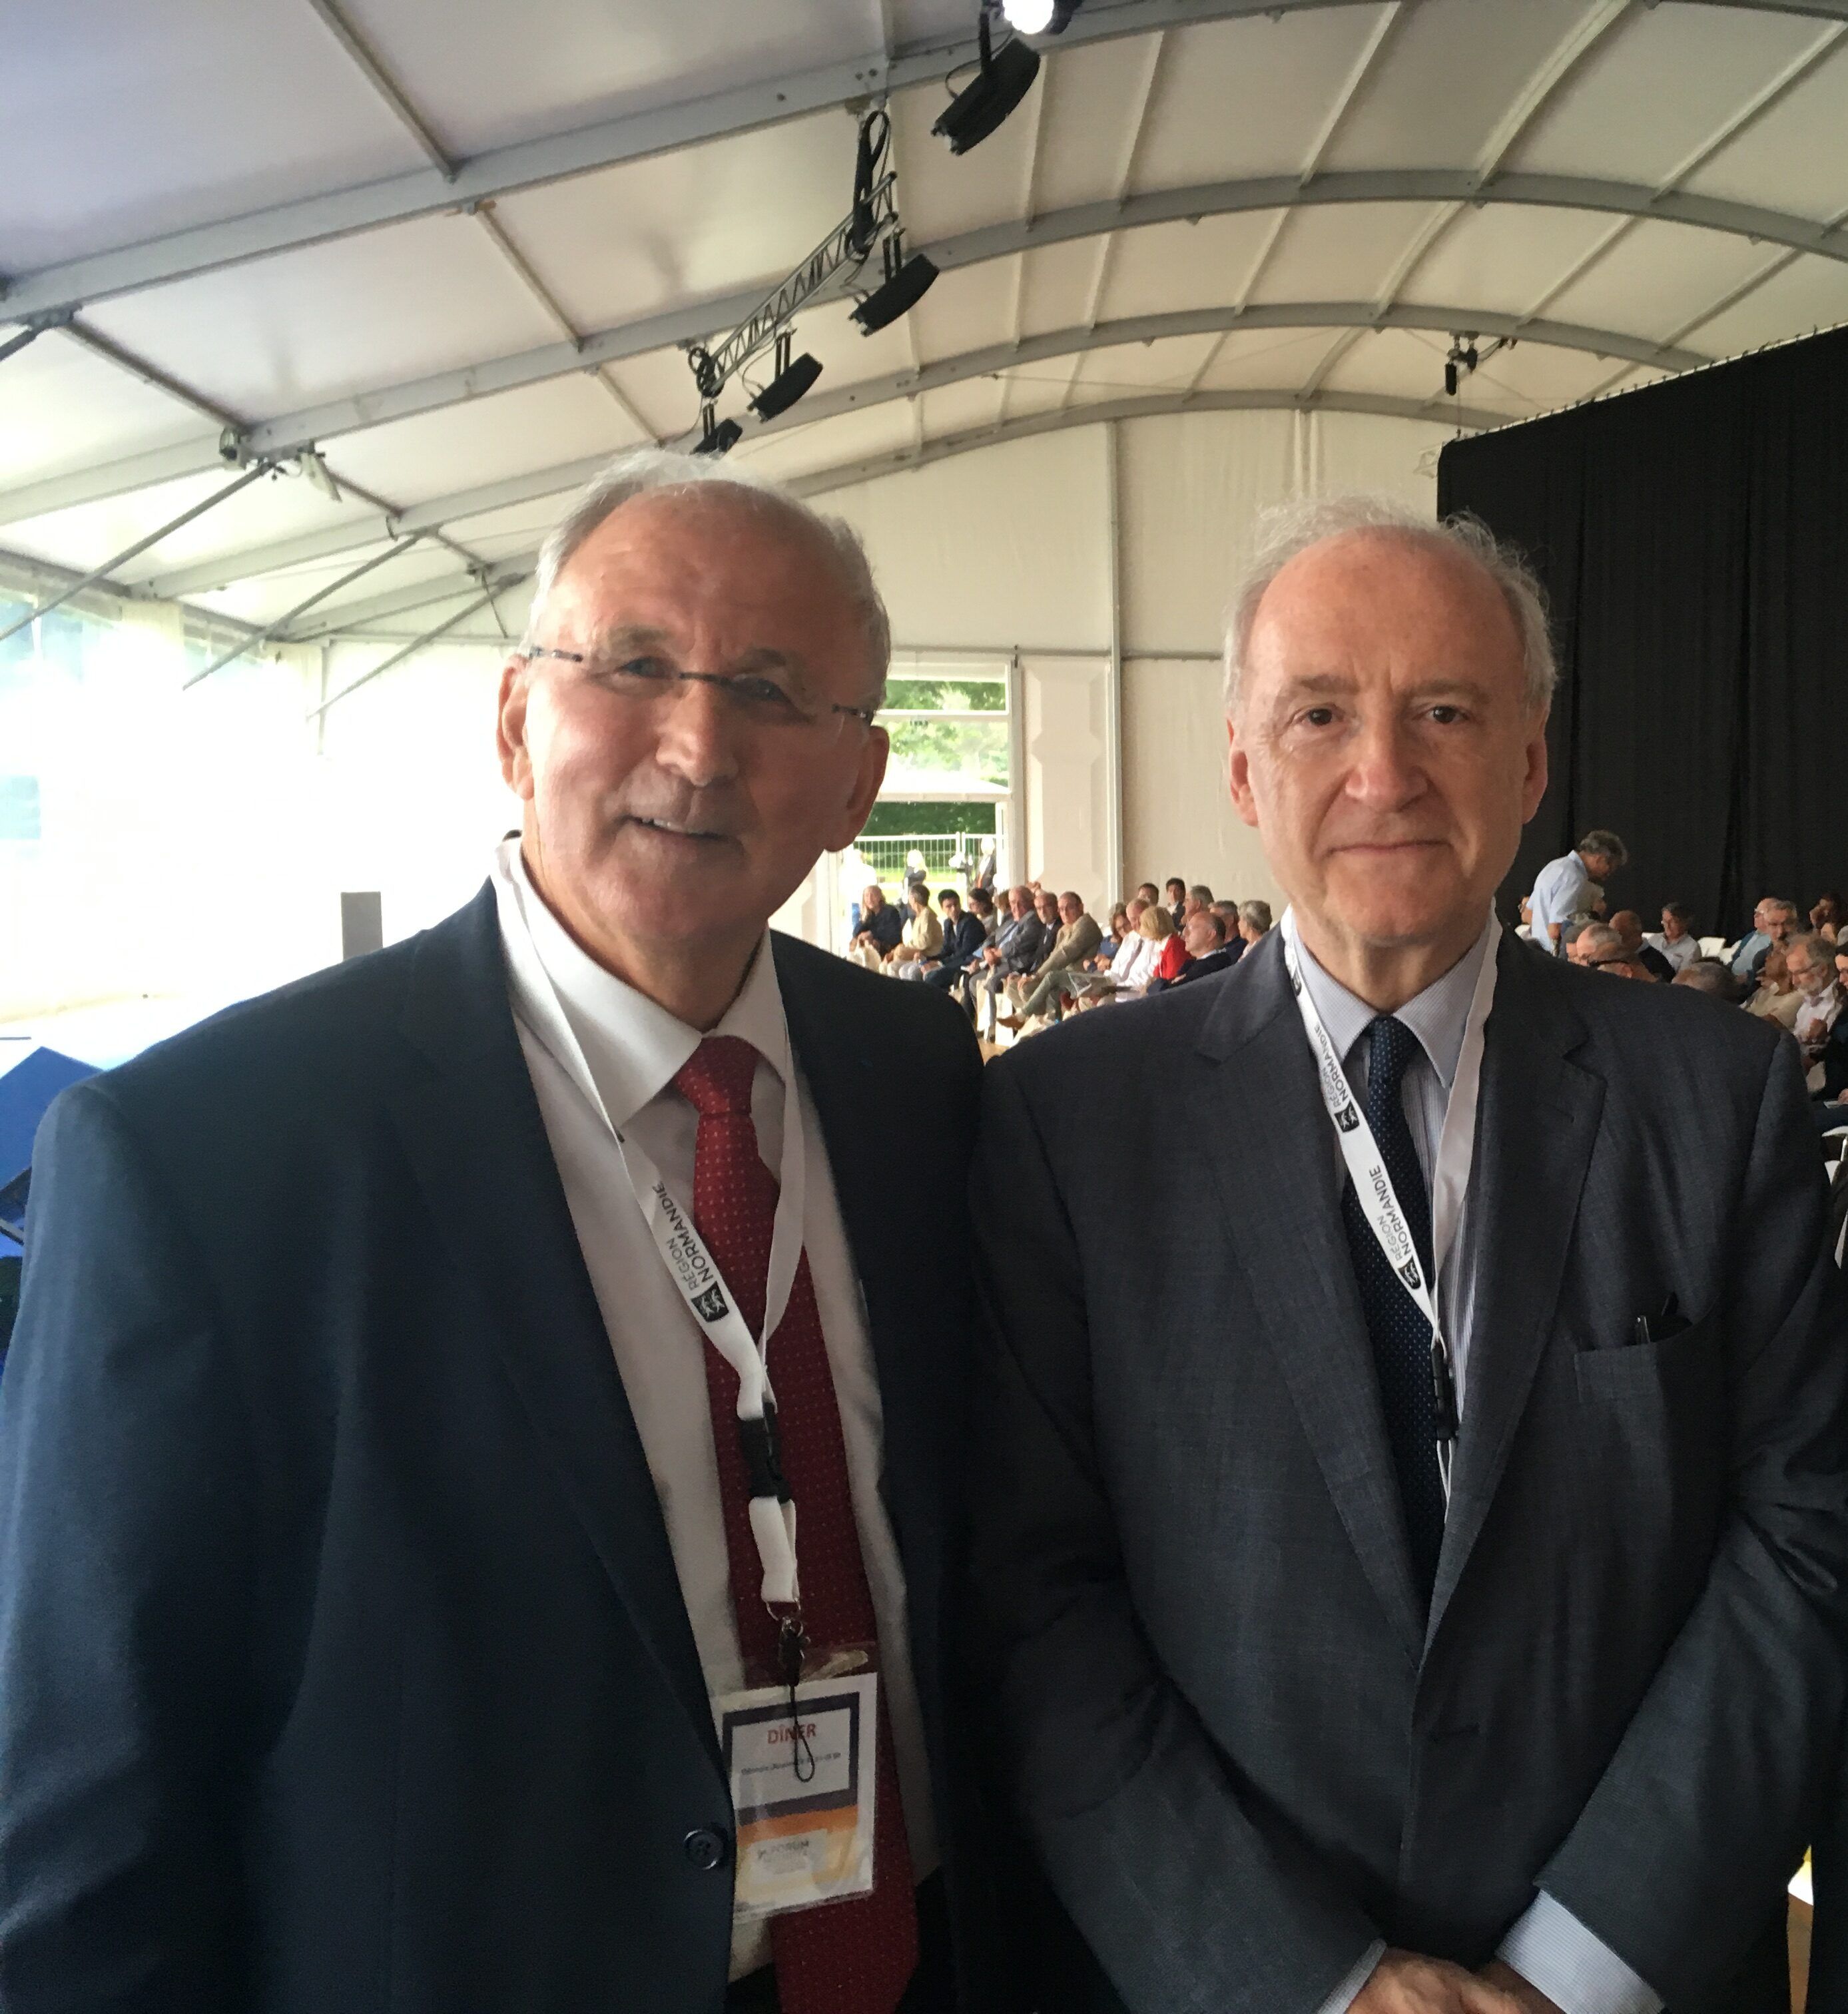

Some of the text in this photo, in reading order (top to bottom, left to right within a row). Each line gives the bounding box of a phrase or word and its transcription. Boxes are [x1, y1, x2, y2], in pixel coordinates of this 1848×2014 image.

[1314, 1024, 1349, 1102] NORMANDIE
[653, 1181, 714, 1283] NORMANDIE
[1369, 1165, 1411, 1255] NORMANDIE
[667, 1237, 699, 1291] RÉGION
